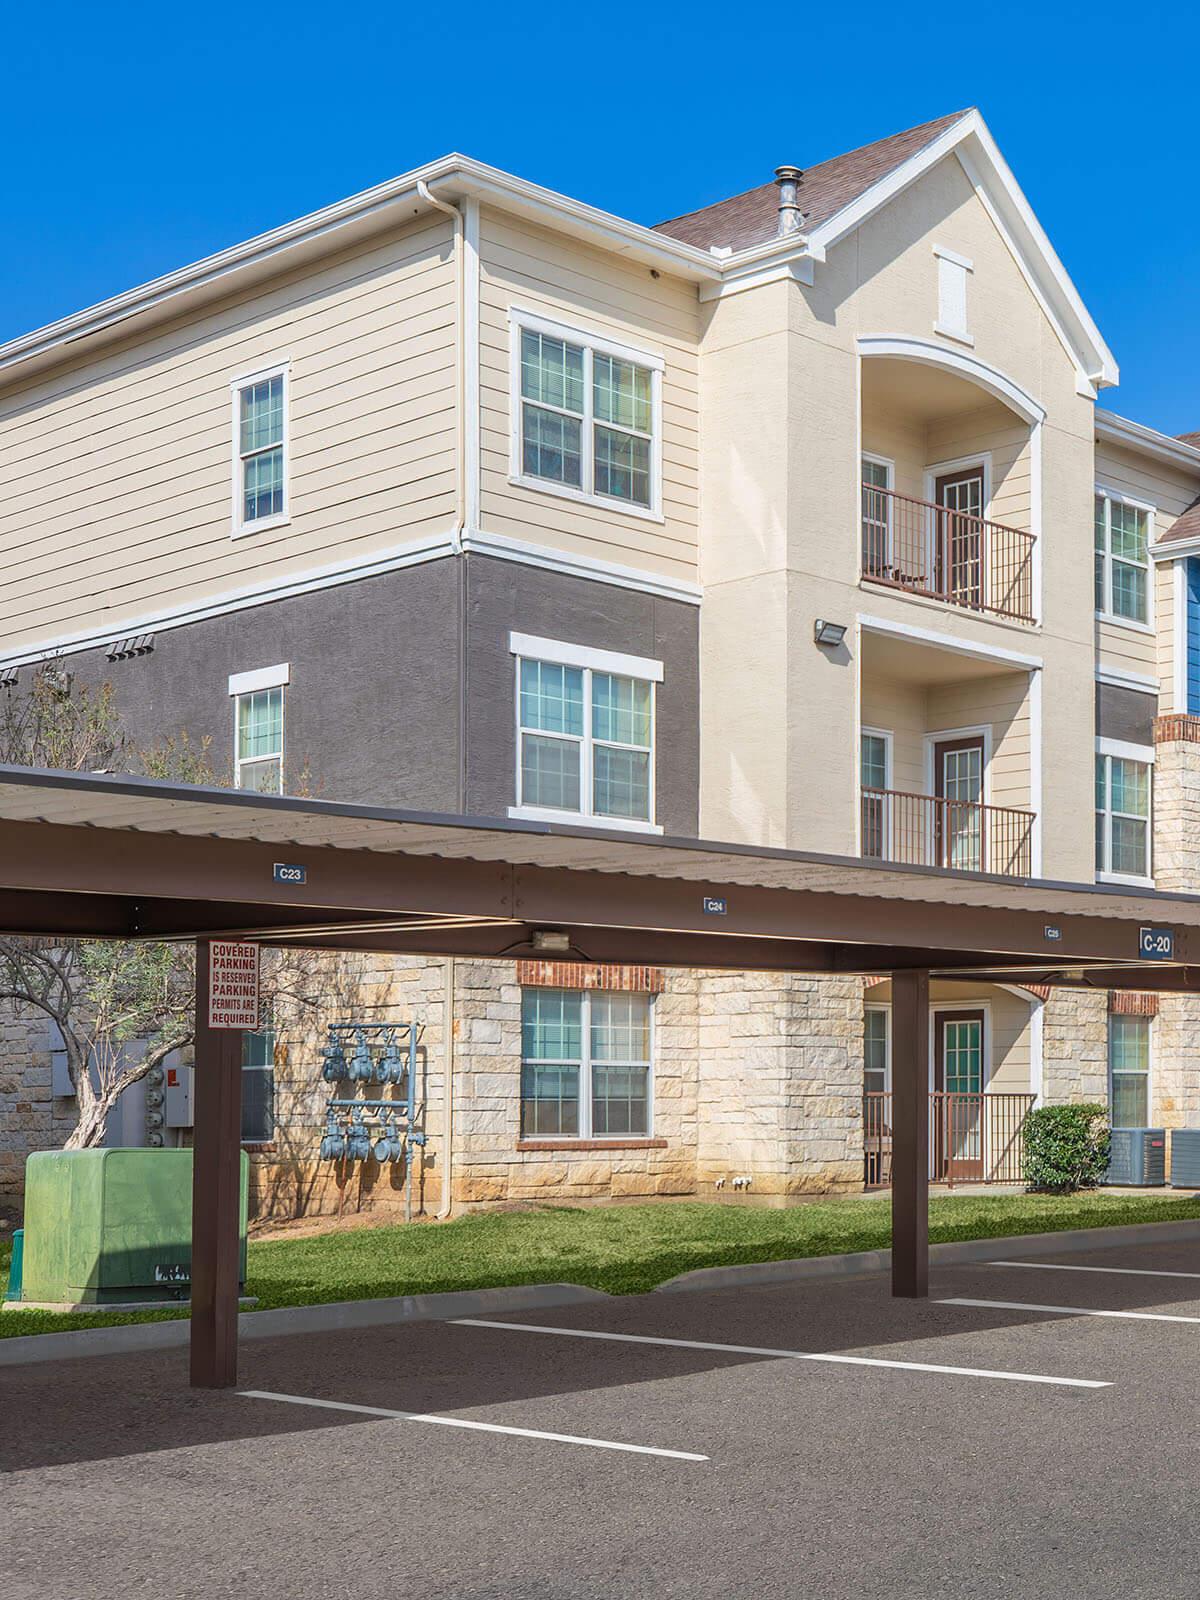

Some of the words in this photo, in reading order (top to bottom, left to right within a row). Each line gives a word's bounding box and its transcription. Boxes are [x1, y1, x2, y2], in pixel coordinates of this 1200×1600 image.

[280, 868, 301, 880] C23
[1143, 934, 1171, 953] C-20
[212, 944, 256, 958] COVERED
[212, 958, 256, 970] PARKING
[212, 971, 220, 982] IS
[221, 971, 256, 984] RESERVED
[212, 984, 256, 997] PARKING
[211, 998, 241, 1010] PERMITS
[242, 999, 255, 1010] ARE
[211, 1012, 255, 1024] REQUIRED
